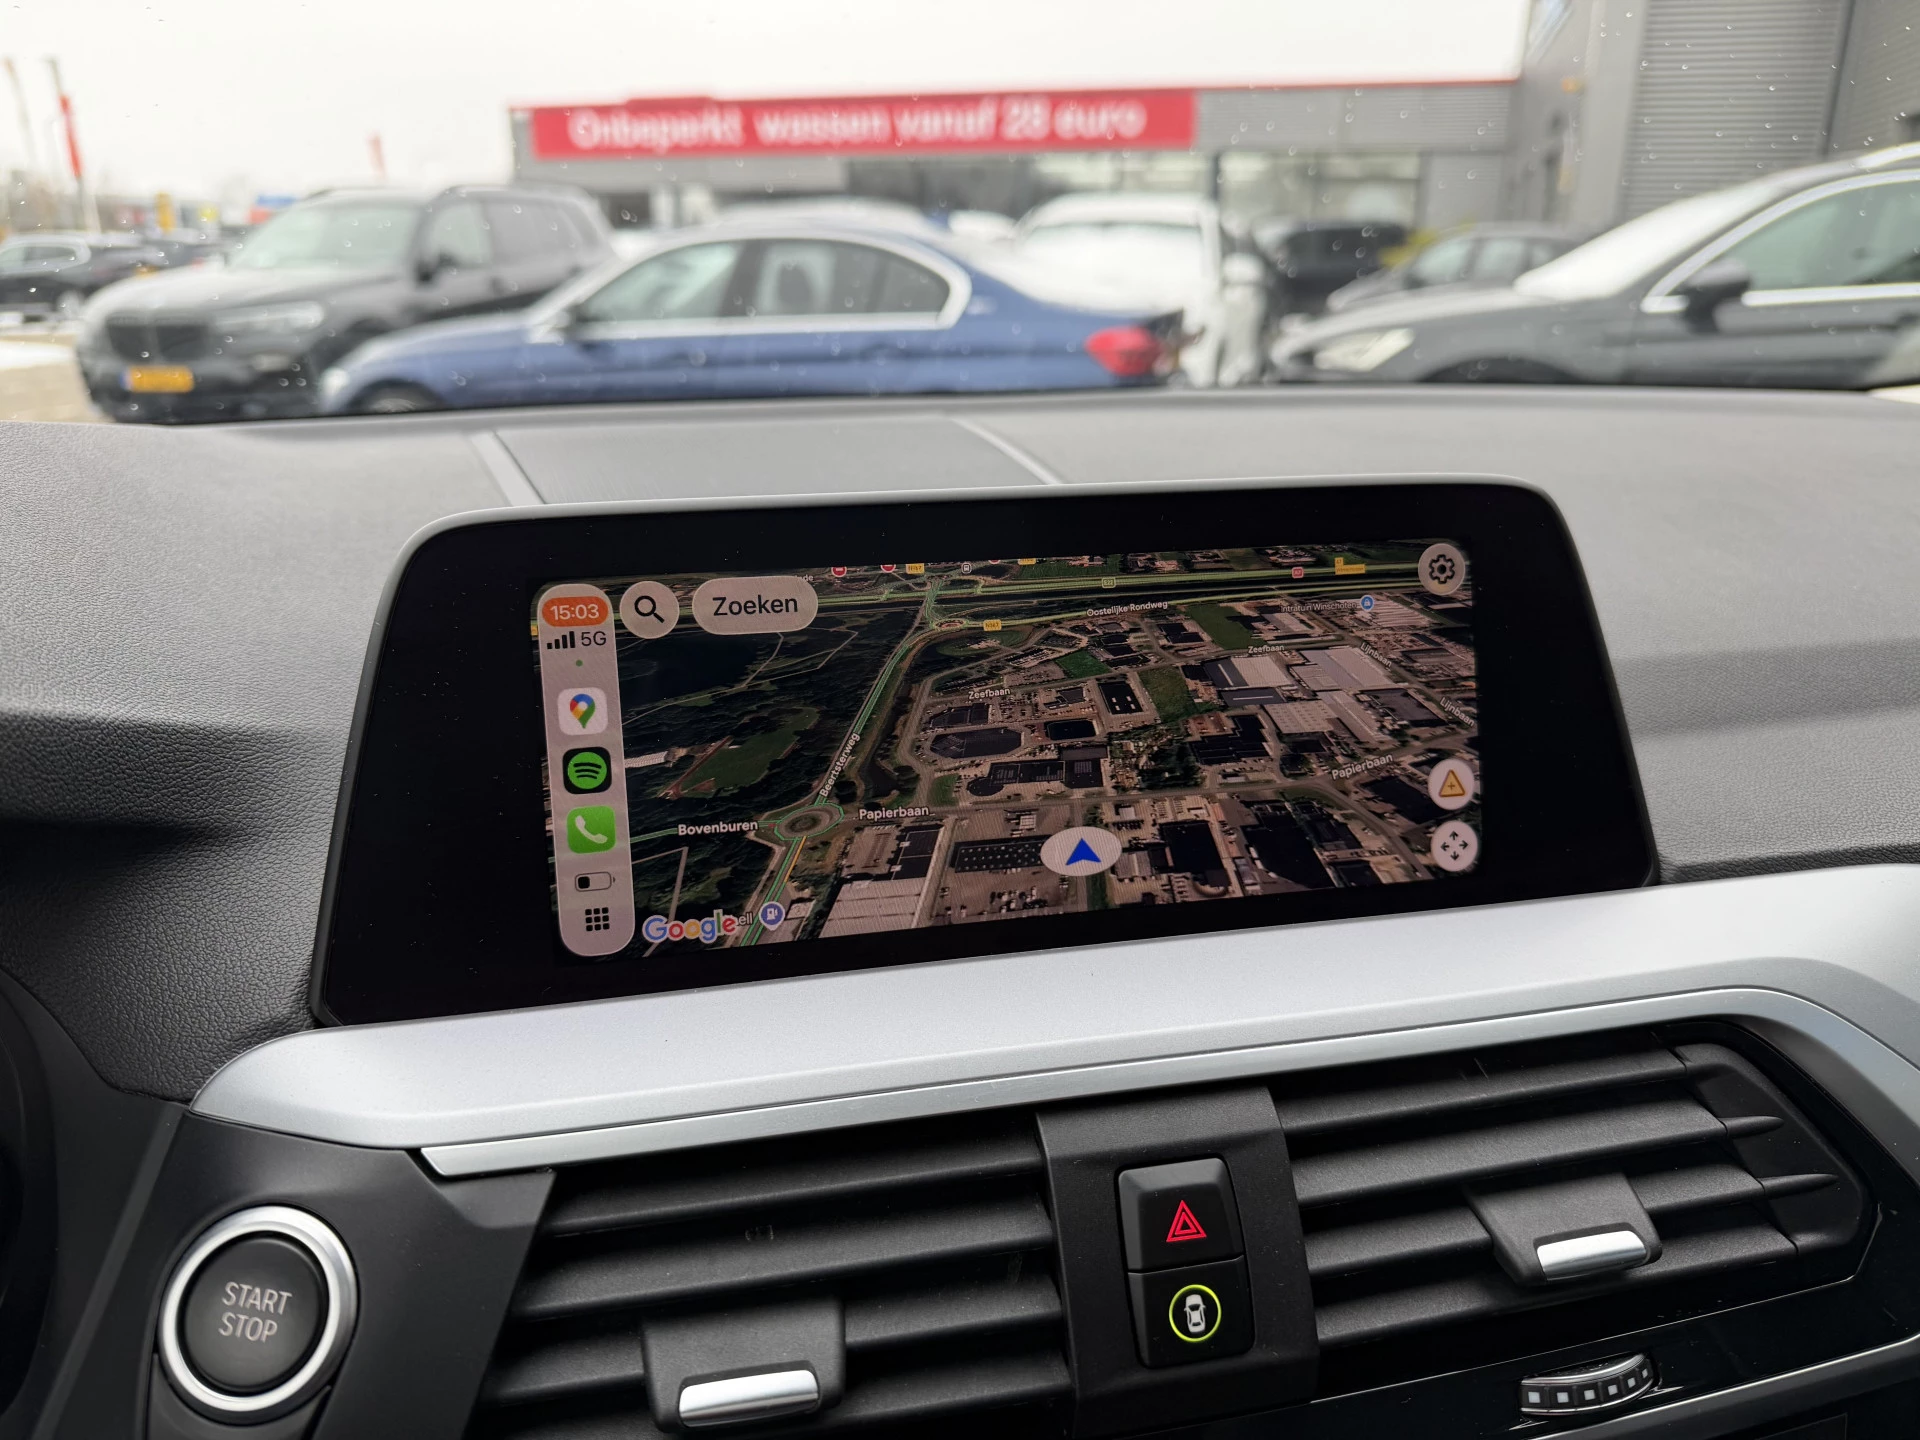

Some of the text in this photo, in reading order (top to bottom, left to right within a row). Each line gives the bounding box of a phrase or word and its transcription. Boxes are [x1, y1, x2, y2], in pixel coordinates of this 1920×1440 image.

[550, 603, 600, 621] 15:03
[713, 594, 798, 617] Zoeken
[1130, 600, 1168, 613] Rondweg
[580, 631, 607, 647] 5G
[1248, 644, 1285, 654] Zeefbaan
[968, 688, 1011, 700] Zeefbaan
[819, 732, 861, 797] Beertsterweg
[1331, 752, 1394, 780] Papierbaan
[858, 805, 929, 820] Papierbaan
[677, 820, 758, 836] Bovenburen
[642, 909, 737, 943] Google
[221, 1281, 292, 1315] START
[218, 1312, 278, 1343] STOP
